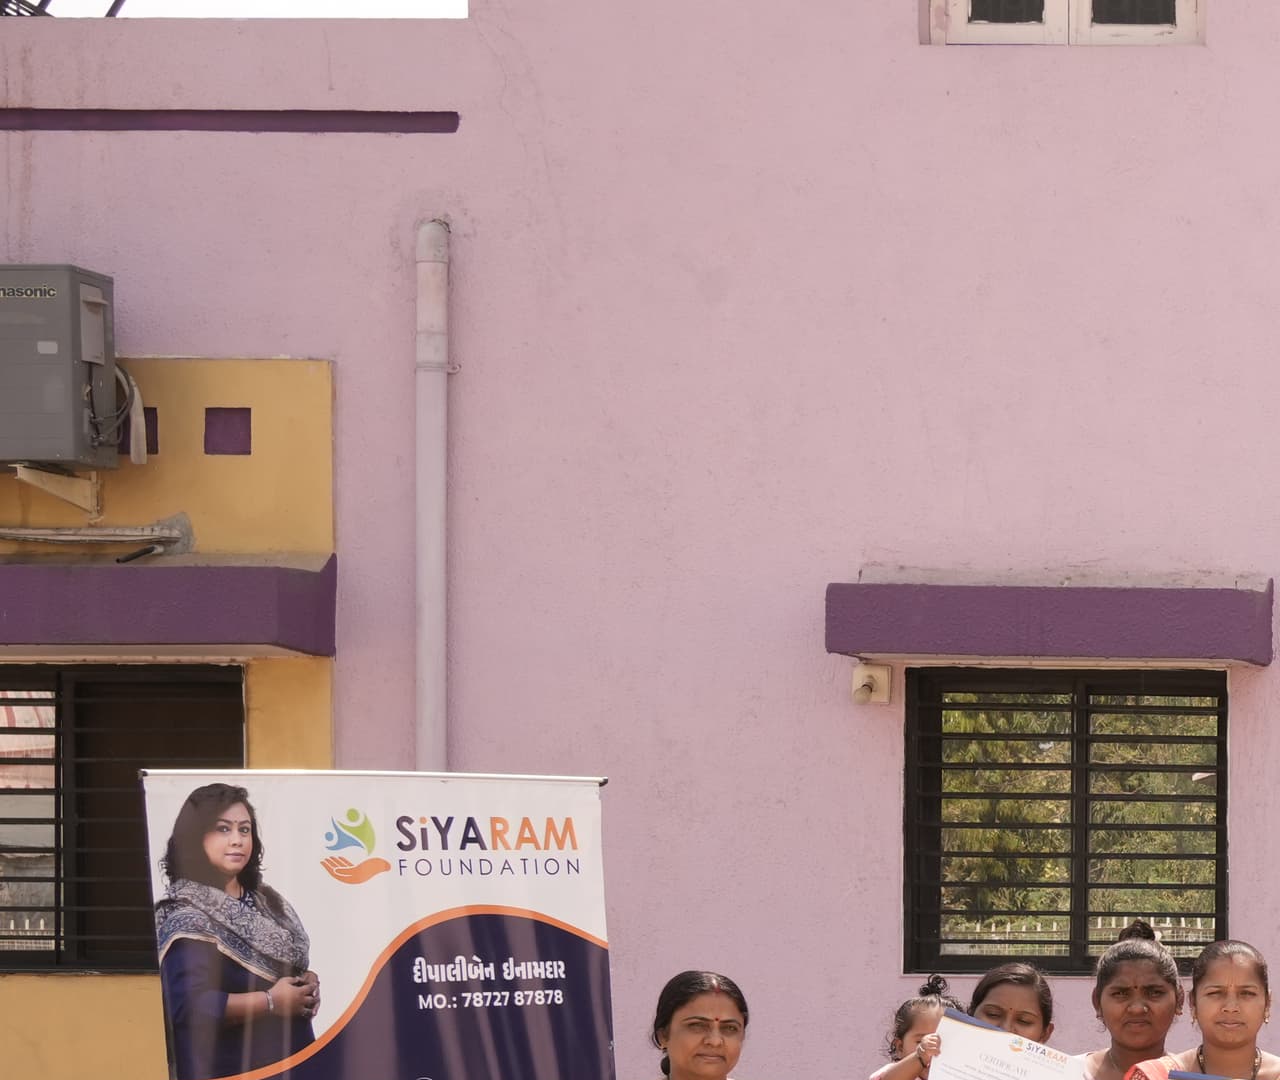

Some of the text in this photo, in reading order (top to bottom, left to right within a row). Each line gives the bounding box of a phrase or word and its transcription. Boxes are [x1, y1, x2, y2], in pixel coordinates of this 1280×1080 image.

[398, 858, 580, 876] FOUNDATION
[418, 989, 564, 1009] MO.: 78727 87878
